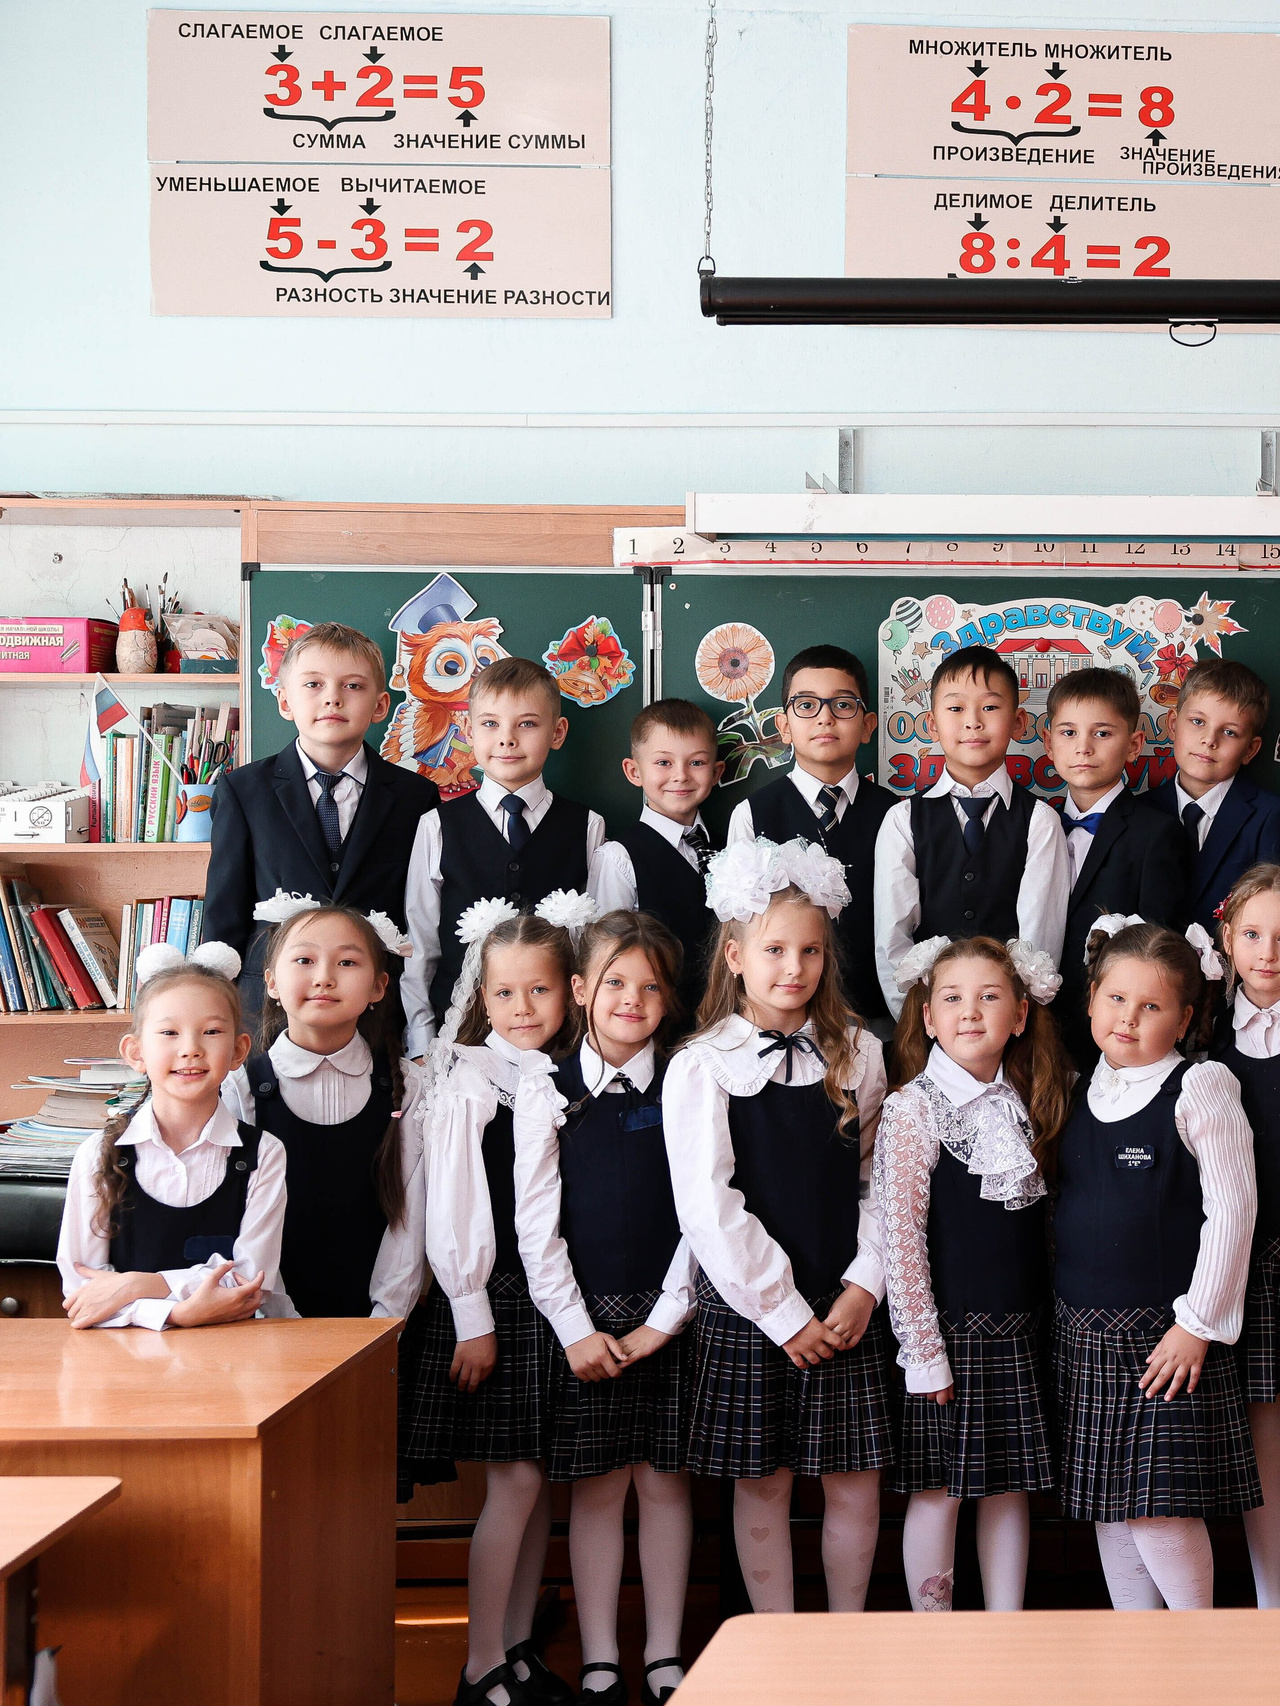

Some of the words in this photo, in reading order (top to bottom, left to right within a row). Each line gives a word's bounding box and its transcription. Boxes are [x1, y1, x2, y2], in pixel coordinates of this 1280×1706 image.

[178, 22, 304, 40] СЛАГАЕМОЕ
[319, 25, 444, 42] СЛАГАЕМОЕ
[909, 39, 1038, 58] МНОЖИТЕЛЬ
[1044, 43, 1172, 61] МНОЖИТЕЛЬ
[292, 133, 366, 149] СУММА
[393, 133, 502, 149] ЗНАЧЕНИЕ
[508, 134, 586, 150] СУММЫ
[933, 143, 1095, 166] ПРОИЗВЕДЕНИЕ
[1120, 147, 1216, 162] ЗНАЧЕНИЕ
[155, 176, 320, 193] УМЕНЬШАЕМОЕ
[341, 177, 486, 195] ВЫЧИТАЕМОЕ
[933, 193, 1033, 211] ДЕЛИМОЕ
[1049, 194, 1157, 213] ДЕЛИТЕЛЬ
[276, 287, 383, 303] РАЗНОСТЬ
[389, 288, 497, 305] ЗНАЧЕНИЕ
[504, 286, 613, 306] РАЗНОСТИ
[629, 538, 639, 555] 1
[672, 538, 685, 555] 2
[719, 541, 731, 554] 3
[764, 541, 777, 553] 4
[811, 541, 822, 553] 5
[856, 542, 869, 554] 6
[1216, 543, 1237, 557] 14
[0, 636, 64, 647] ОДВИЖНАЯ
[152, 760, 160, 784] ЯЗЫК
[147, 786, 158, 825] РУССКИЙ
